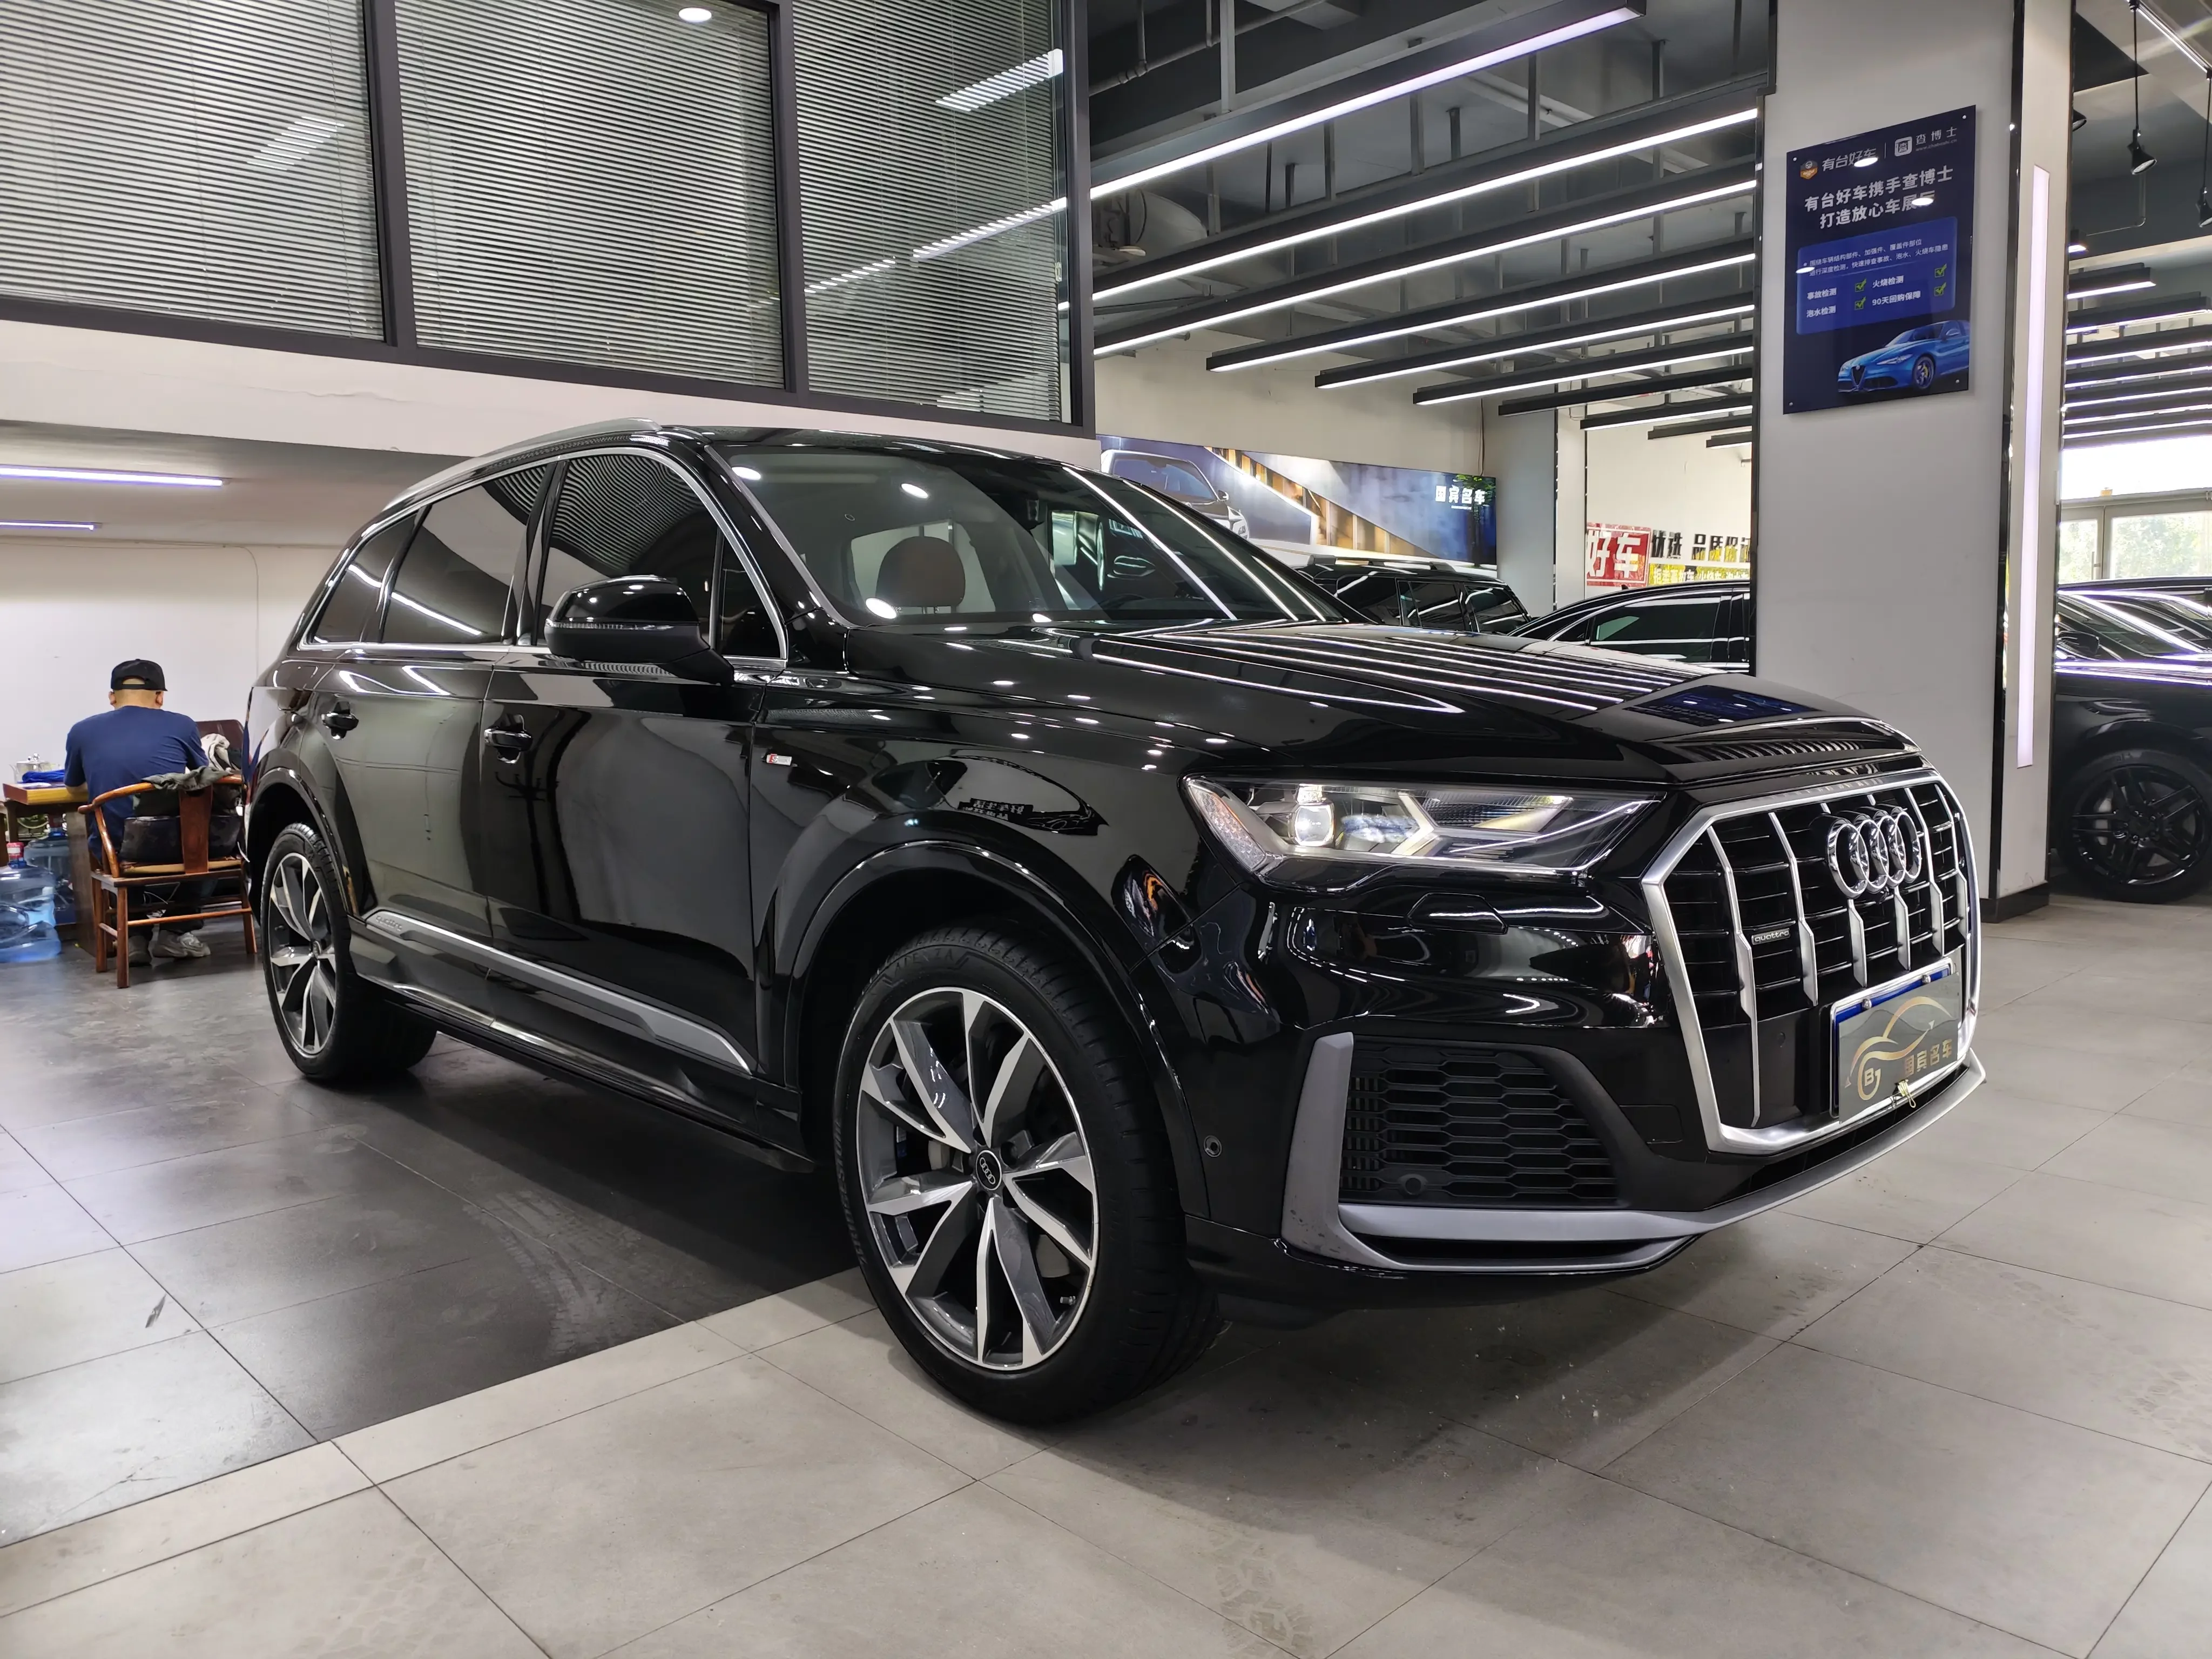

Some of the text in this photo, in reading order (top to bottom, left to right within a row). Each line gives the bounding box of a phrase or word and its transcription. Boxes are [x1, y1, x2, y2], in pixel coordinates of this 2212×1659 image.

[1916, 126, 1957, 145] 查博士
[1804, 165, 1953, 212] 有台好车携手查博士
[1872, 291, 1921, 306] 90天回购保障
[1754, 929, 1790, 942] quattro
